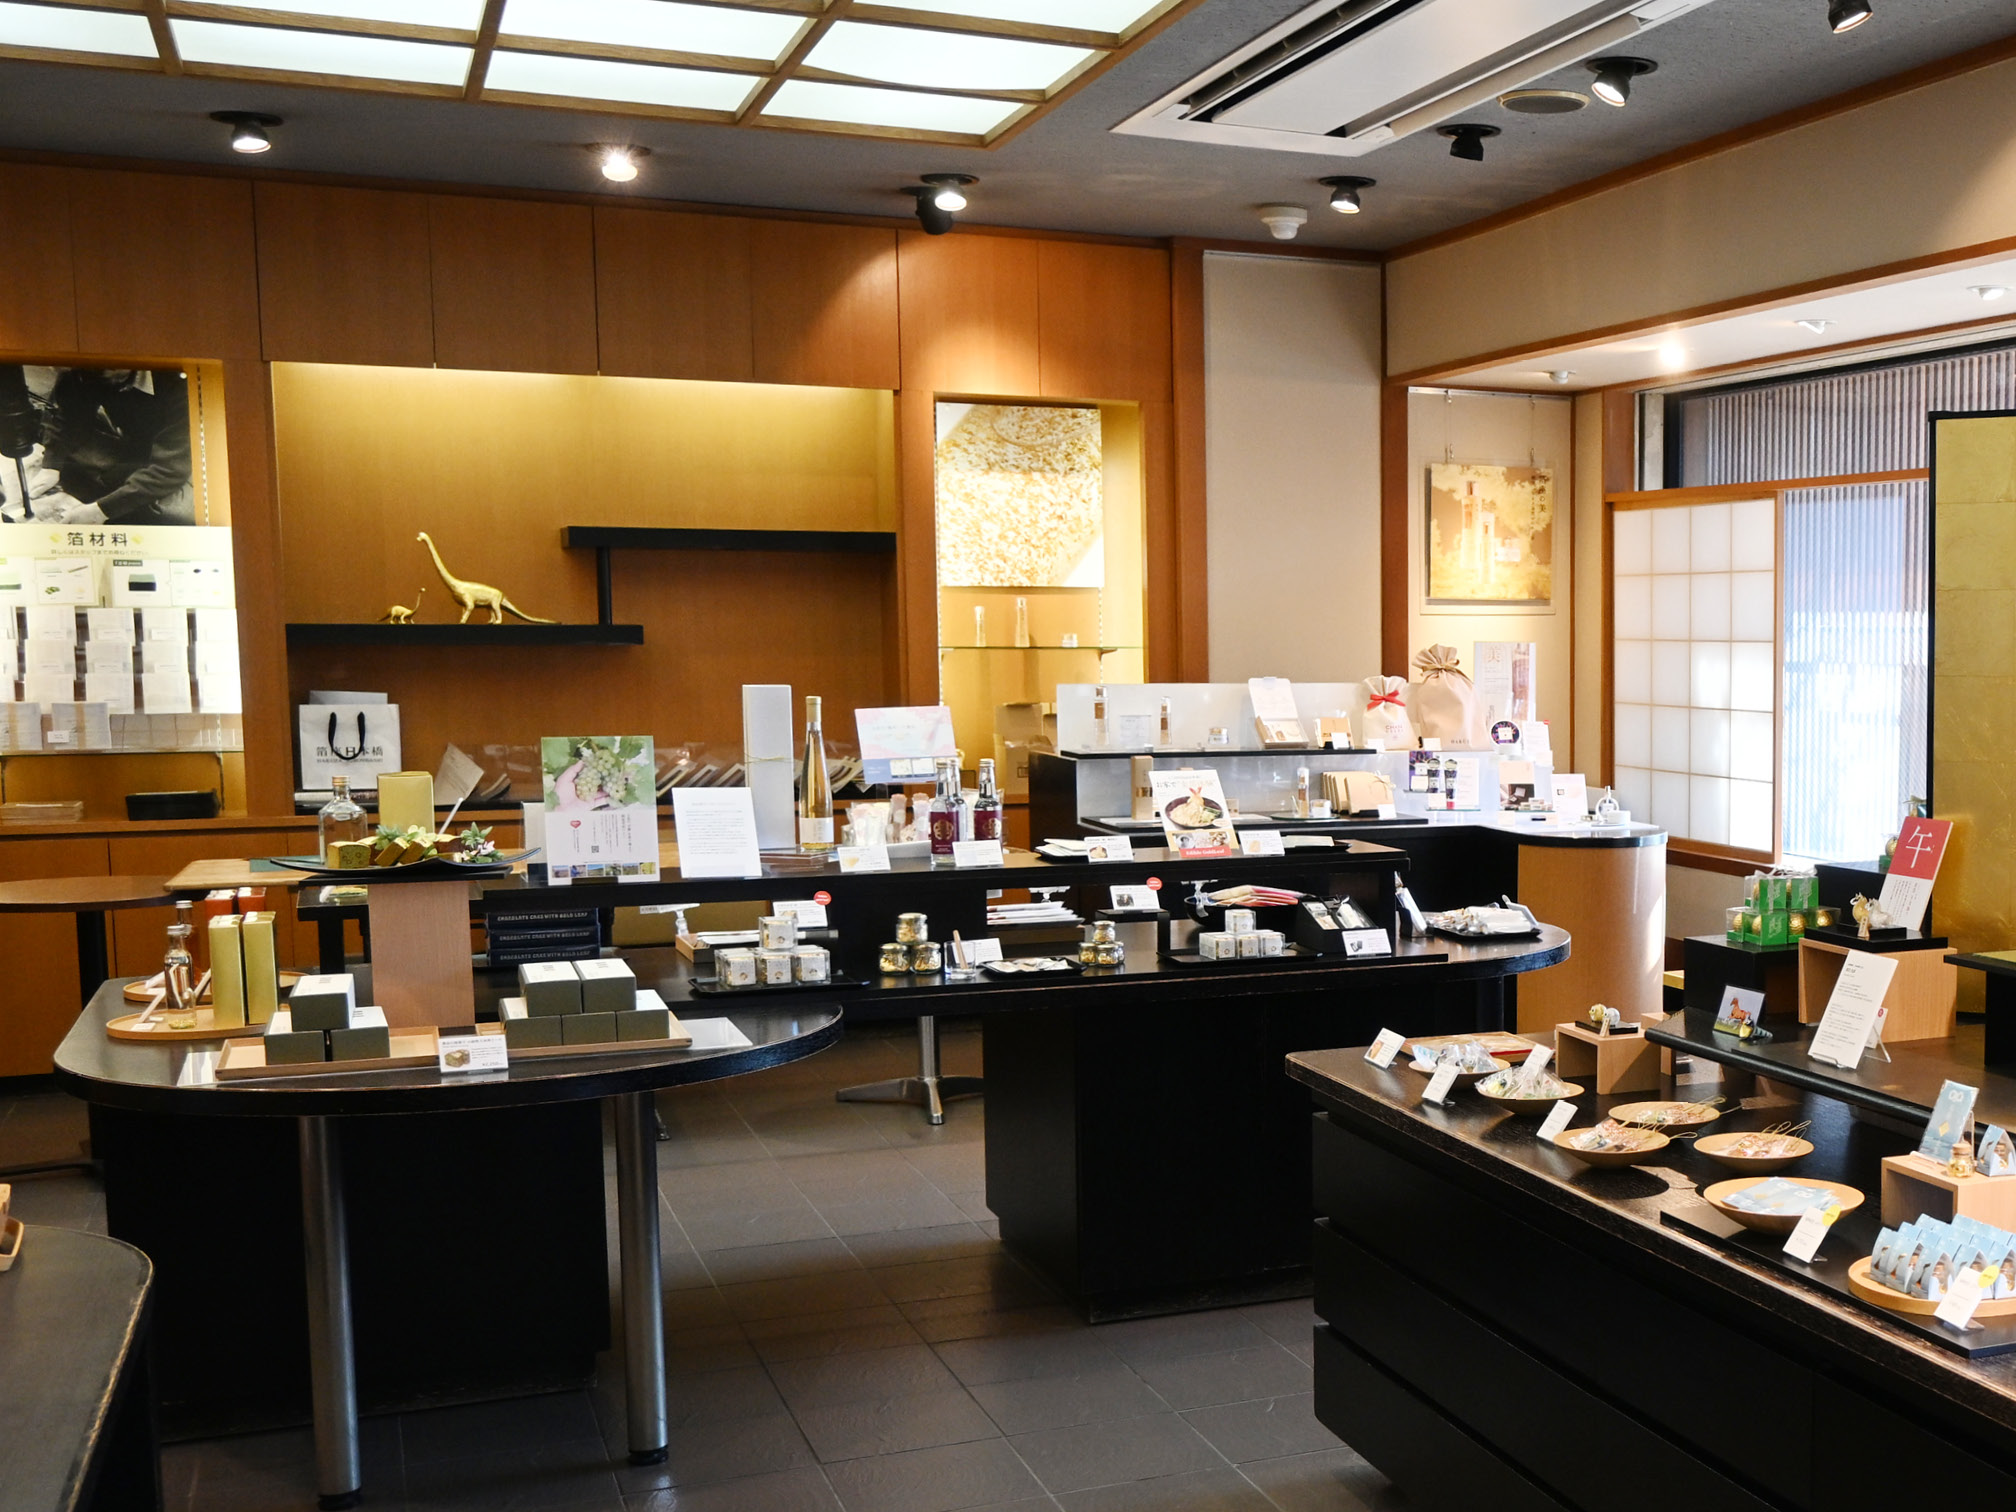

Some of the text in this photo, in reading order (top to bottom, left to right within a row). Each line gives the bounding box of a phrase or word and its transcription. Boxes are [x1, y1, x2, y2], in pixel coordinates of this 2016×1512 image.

[67, 532, 128, 547] 箔材料
[1905, 825, 1933, 869] 午
